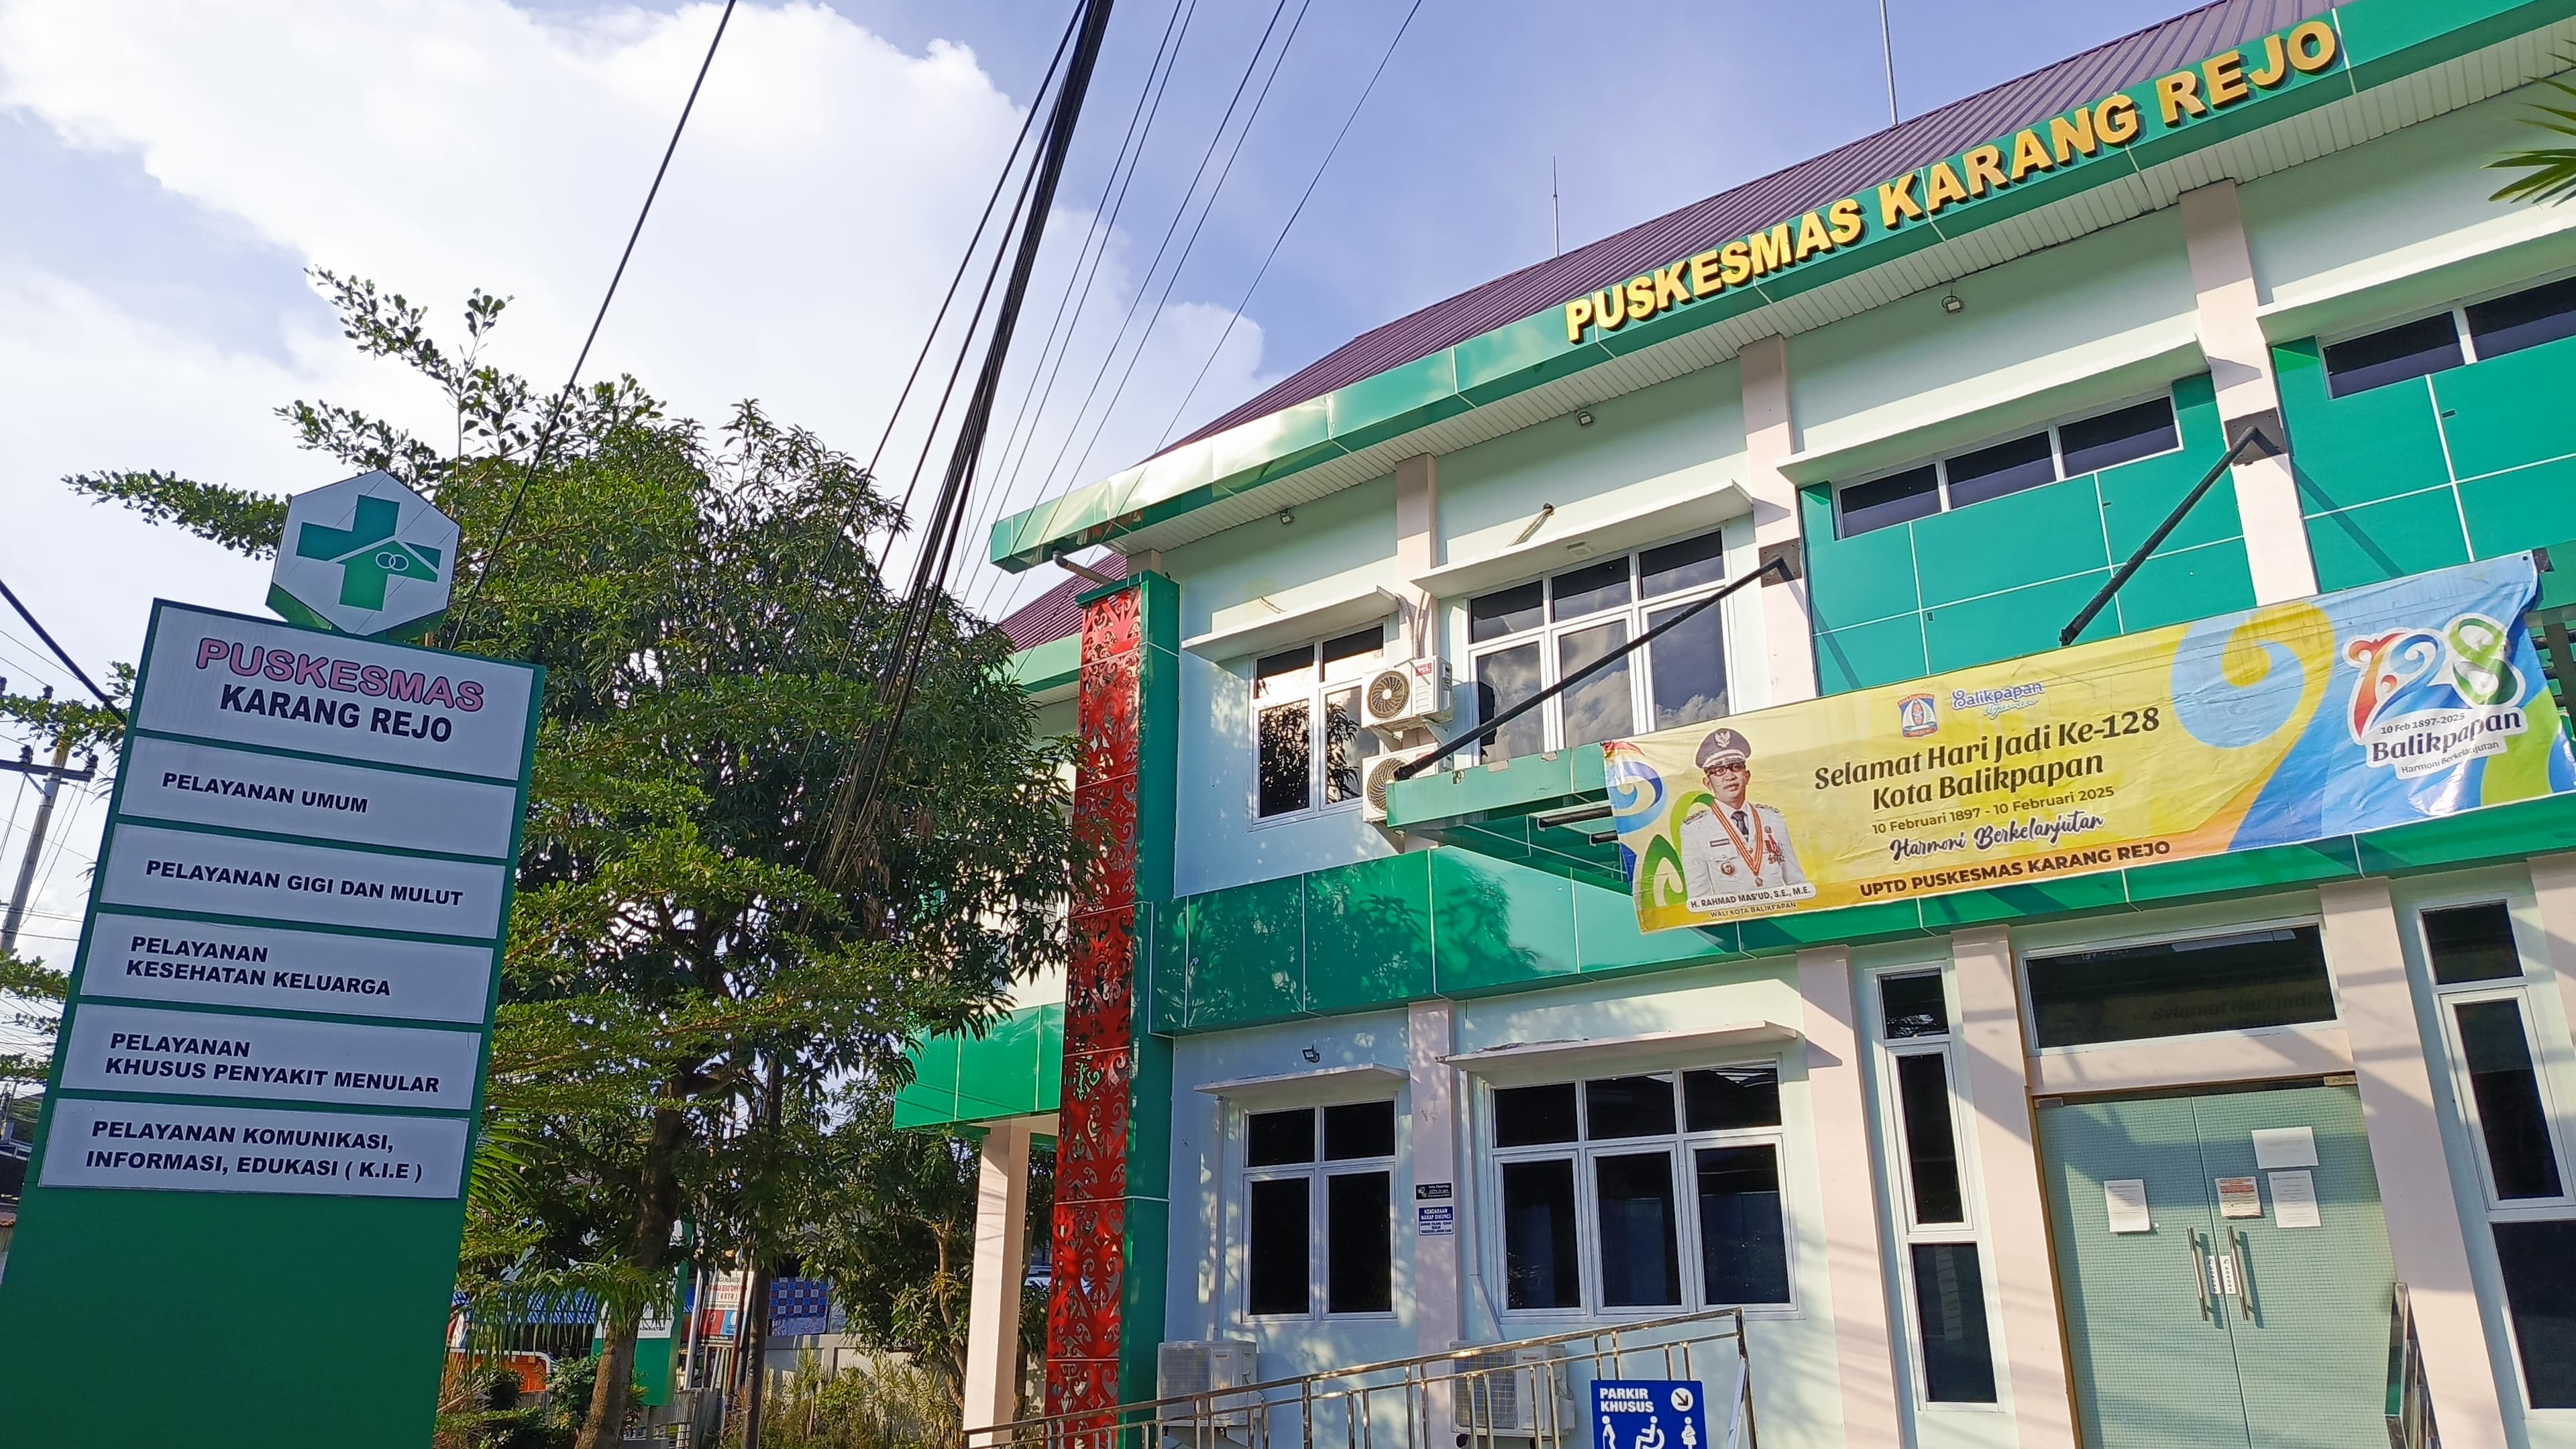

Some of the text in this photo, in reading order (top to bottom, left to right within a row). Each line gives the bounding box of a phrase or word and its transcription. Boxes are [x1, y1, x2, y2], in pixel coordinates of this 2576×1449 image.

[1565, 19, 2340, 345] PUSKESMAS KARANG REJO
[195, 637, 484, 712] PUSKESMAS
[1952, 682, 2043, 708] Balikpapan
[219, 684, 453, 743] KARANG REJO
[2381, 712, 2465, 735] 10 Feb 1897-2025
[1815, 707, 2160, 790] Selamat Hari Jadi Ke-128
[2372, 711, 2522, 761] Balikpapan
[1872, 753, 2104, 810] Kota Balikpapan
[2402, 759, 2440, 773] Harmoni
[162, 772, 368, 814] PELAYANAN UMUM
[1872, 822, 1886, 835] 10
[1889, 812, 1947, 833] Februari
[1950, 806, 1980, 824] 1897
[1994, 802, 2009, 816] 10
[2013, 791, 2075, 814] Februari
[2080, 785, 2114, 802] 2025
[1889, 810, 2105, 864] Harmoni Berkelanjutan
[146, 860, 464, 906] PELAYANAN GIGI DAN MULUT
[1860, 841, 2171, 898] UPTD PUSKESMAS KARANG REJO
[1701, 896, 1736, 906] RAHMAD
[1738, 892, 1773, 902] MAS'UD,
[1774, 890, 1791, 898] S.E.,
[1792, 887, 1811, 895] M.E.
[1710, 910, 1729, 918] WALI
[130, 936, 268, 963] PELAYANAN
[126, 961, 391, 996] KESEHATAN KELUARGA
[109, 1032, 250, 1058] PELAYANAN
[105, 1057, 440, 1093] KHUSUS PENYAKIT MENULAR
[91, 1121, 394, 1153] PELAYANAN KOMUNIKASI,
[85, 1150, 229, 1175] INFORMASI,
[236, 1157, 338, 1177] EDUKASI
[1600, 1388, 1648, 1399] PARKIR
[1601, 1401, 1654, 1412] KHUSUS
